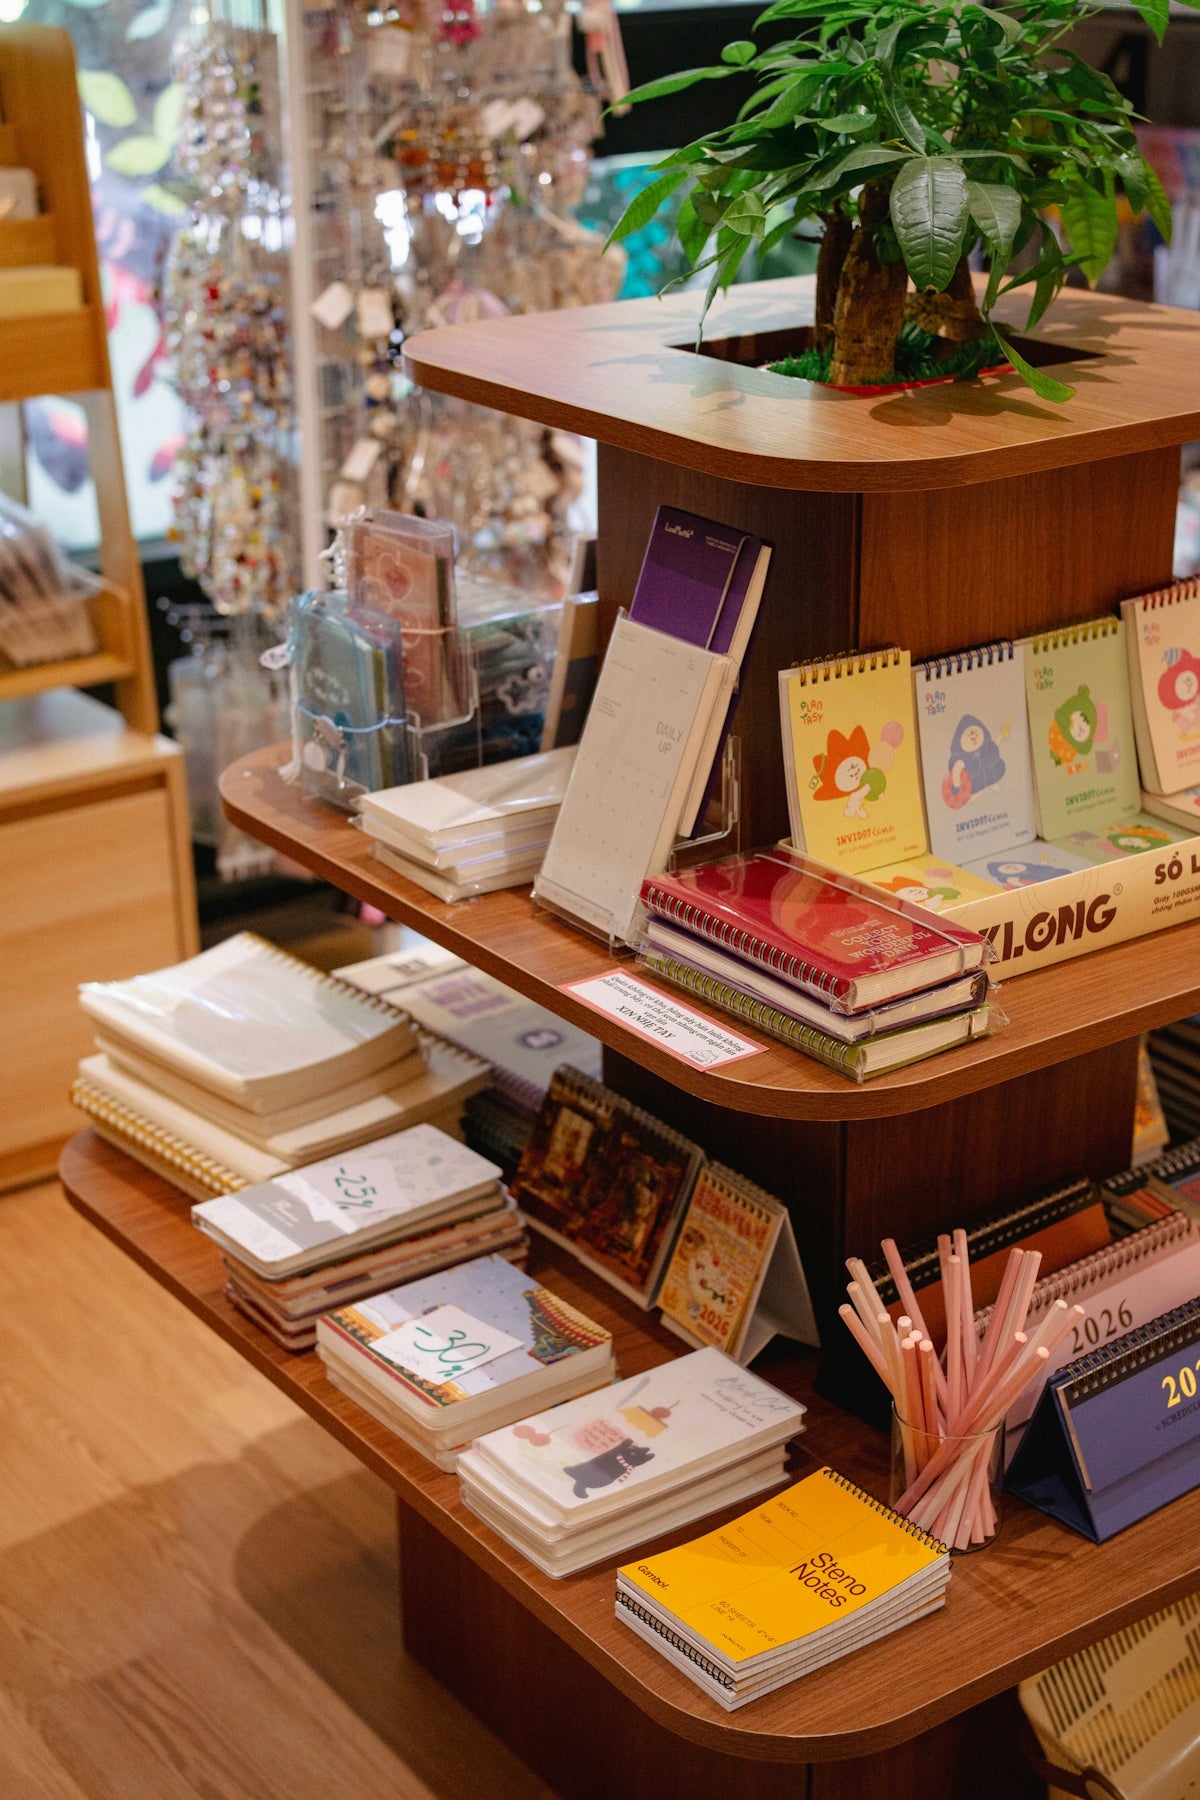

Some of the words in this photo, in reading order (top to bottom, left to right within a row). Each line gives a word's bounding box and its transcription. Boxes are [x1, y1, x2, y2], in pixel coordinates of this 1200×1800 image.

[801, 700, 823, 712] PLAN
[926, 703, 946, 717] TASY
[800, 712, 823, 726] TASY
[656, 721, 684, 742] DAILY
[659, 740, 672, 754] UP
[1154, 851, 1183, 885] SỔ
[848, 931, 932, 958] WONDERFUL
[860, 933, 900, 946] YOUR
[616, 1006, 637, 1016] XIN
[633, 1016, 656, 1028] NHẸ
[654, 1027, 676, 1038] TAY
[722, 1038, 744, 1052] không
[700, 1303, 729, 1337] 2026
[1072, 1298, 1134, 1355] 2026
[789, 1562, 847, 1607] Notes
[810, 1553, 867, 1596] Steno
[710, 1604, 727, 1615] LINE
[728, 1607, 756, 1628] SHEETS
